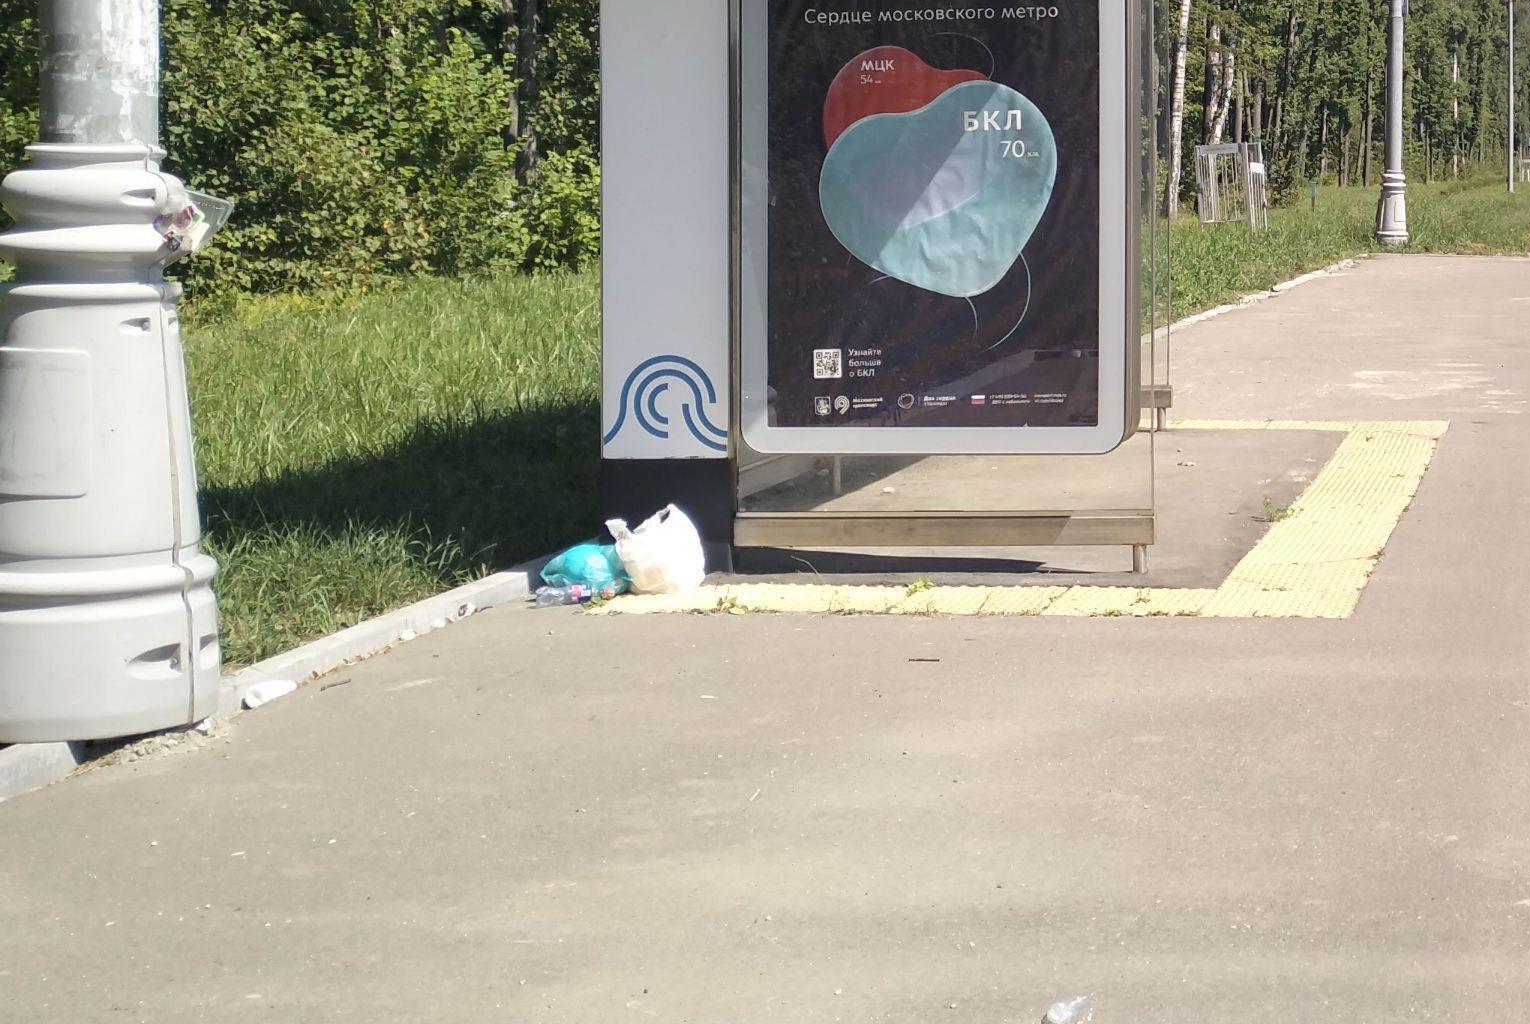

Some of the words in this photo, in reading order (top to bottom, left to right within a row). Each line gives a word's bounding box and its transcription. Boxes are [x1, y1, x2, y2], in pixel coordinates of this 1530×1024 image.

[804, 8, 872, 26] Сердце
[878, 7, 995, 22] московского
[1001, 5, 1059, 21] метро
[860, 59, 895, 72] МЦК
[860, 74, 873, 84] 54
[963, 109, 1022, 132] БКЛ
[1000, 140, 1025, 158] 70
[848, 348, 882, 356] Узнайте
[848, 359, 882, 367] больше
[857, 369, 875, 377] БКЛ
